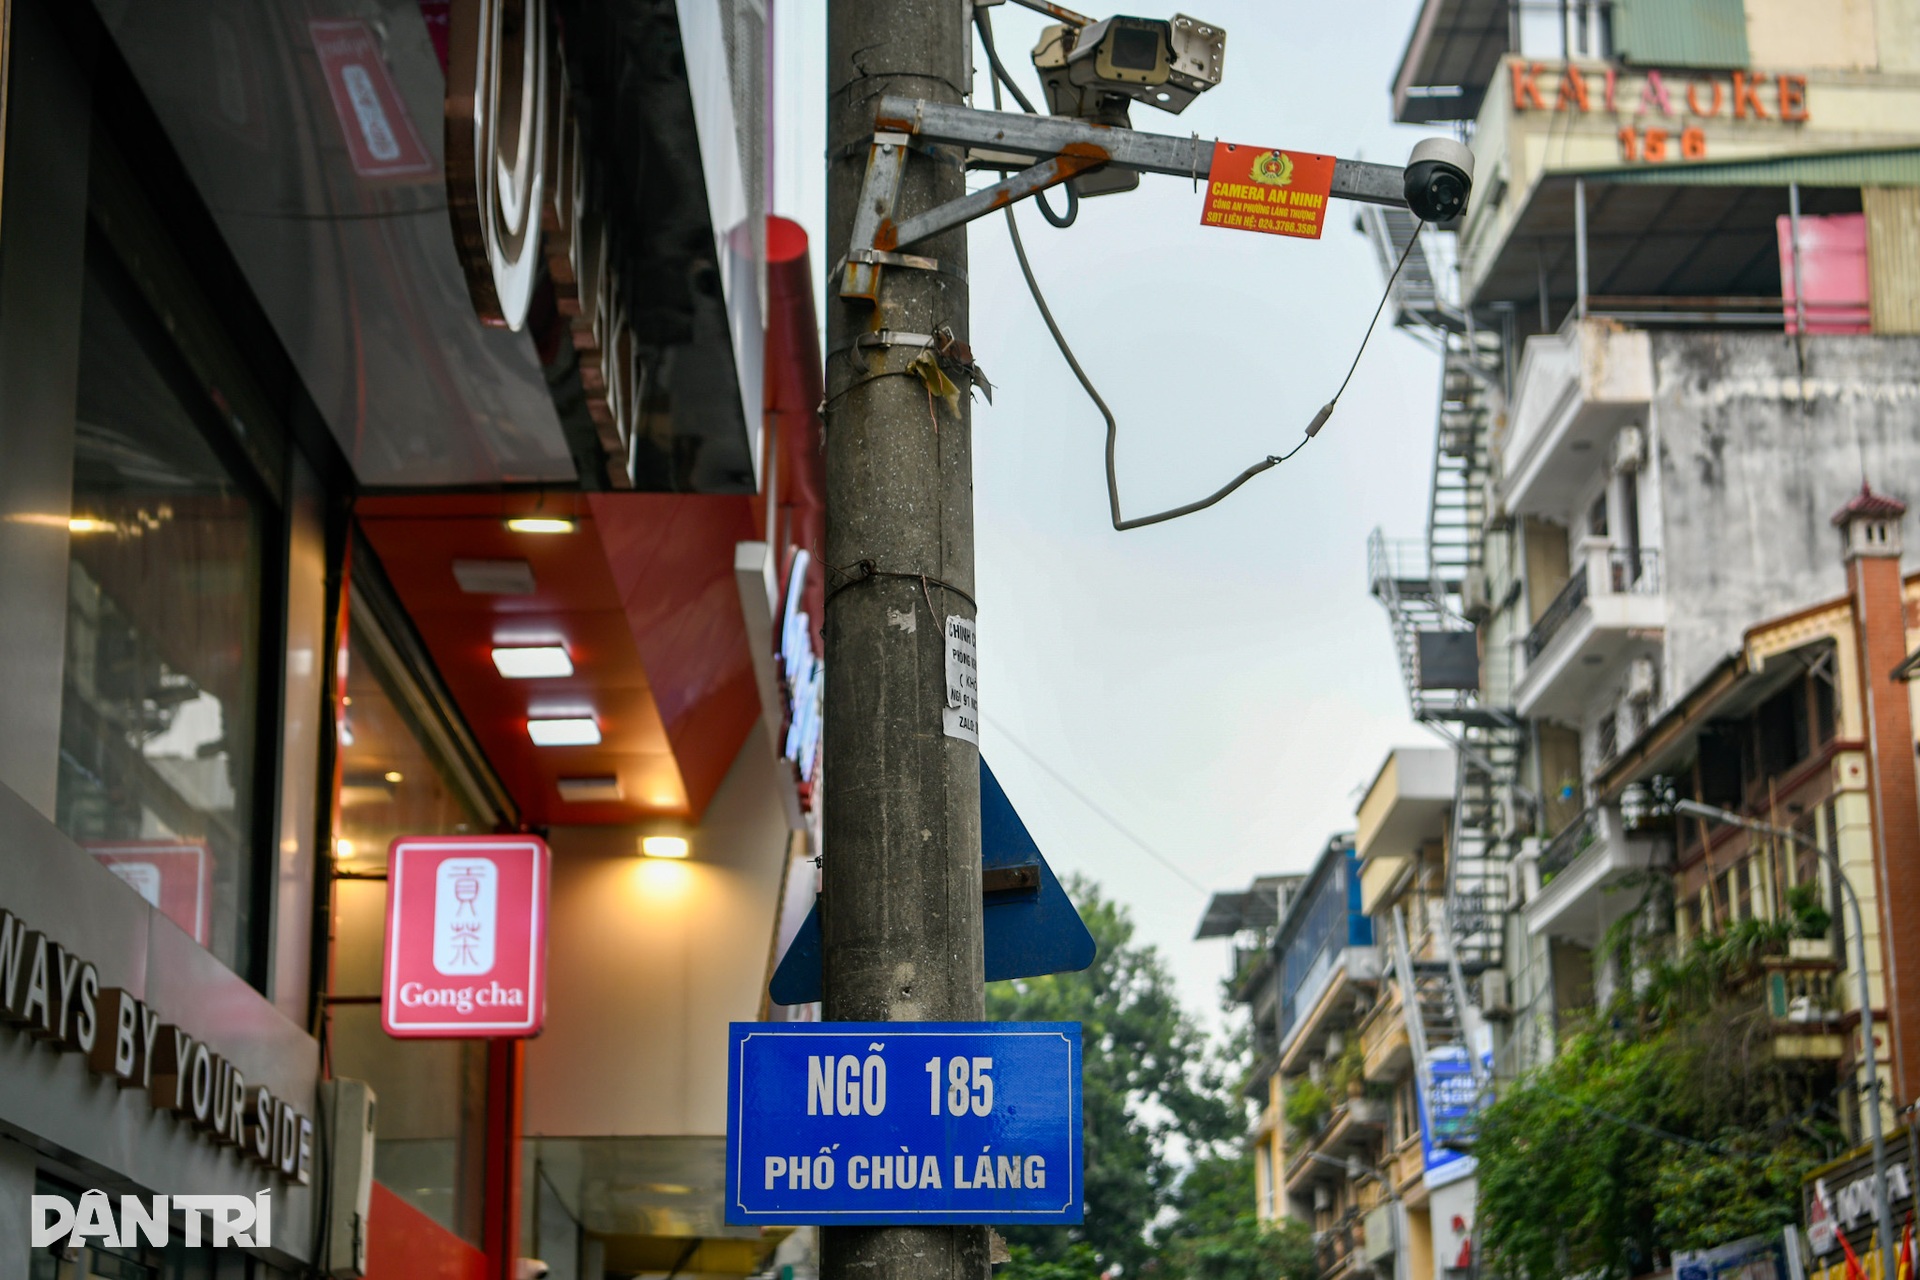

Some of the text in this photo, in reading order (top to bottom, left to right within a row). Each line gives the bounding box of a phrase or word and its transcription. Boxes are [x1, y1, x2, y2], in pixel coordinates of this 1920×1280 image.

[1619, 125, 1706, 163] 156
[1212, 182, 1322, 208] CAMERA AN NINH
[1212, 199, 1316, 222] CÔNG AN PHƯỜNG LÁNG THƯỢNG
[1206, 211, 1223, 223] SĐT
[1223, 212, 1242, 226] LIÊN
[399, 980, 523, 1014] Gong cha
[114, 987, 160, 1089] BY
[174, 1025, 248, 1149] YOUR
[254, 1084, 314, 1187] SIDE
[807, 1042, 994, 1117] NGÕ 185
[764, 1143, 1047, 1191] PHỐ CHÙA LÁNG
